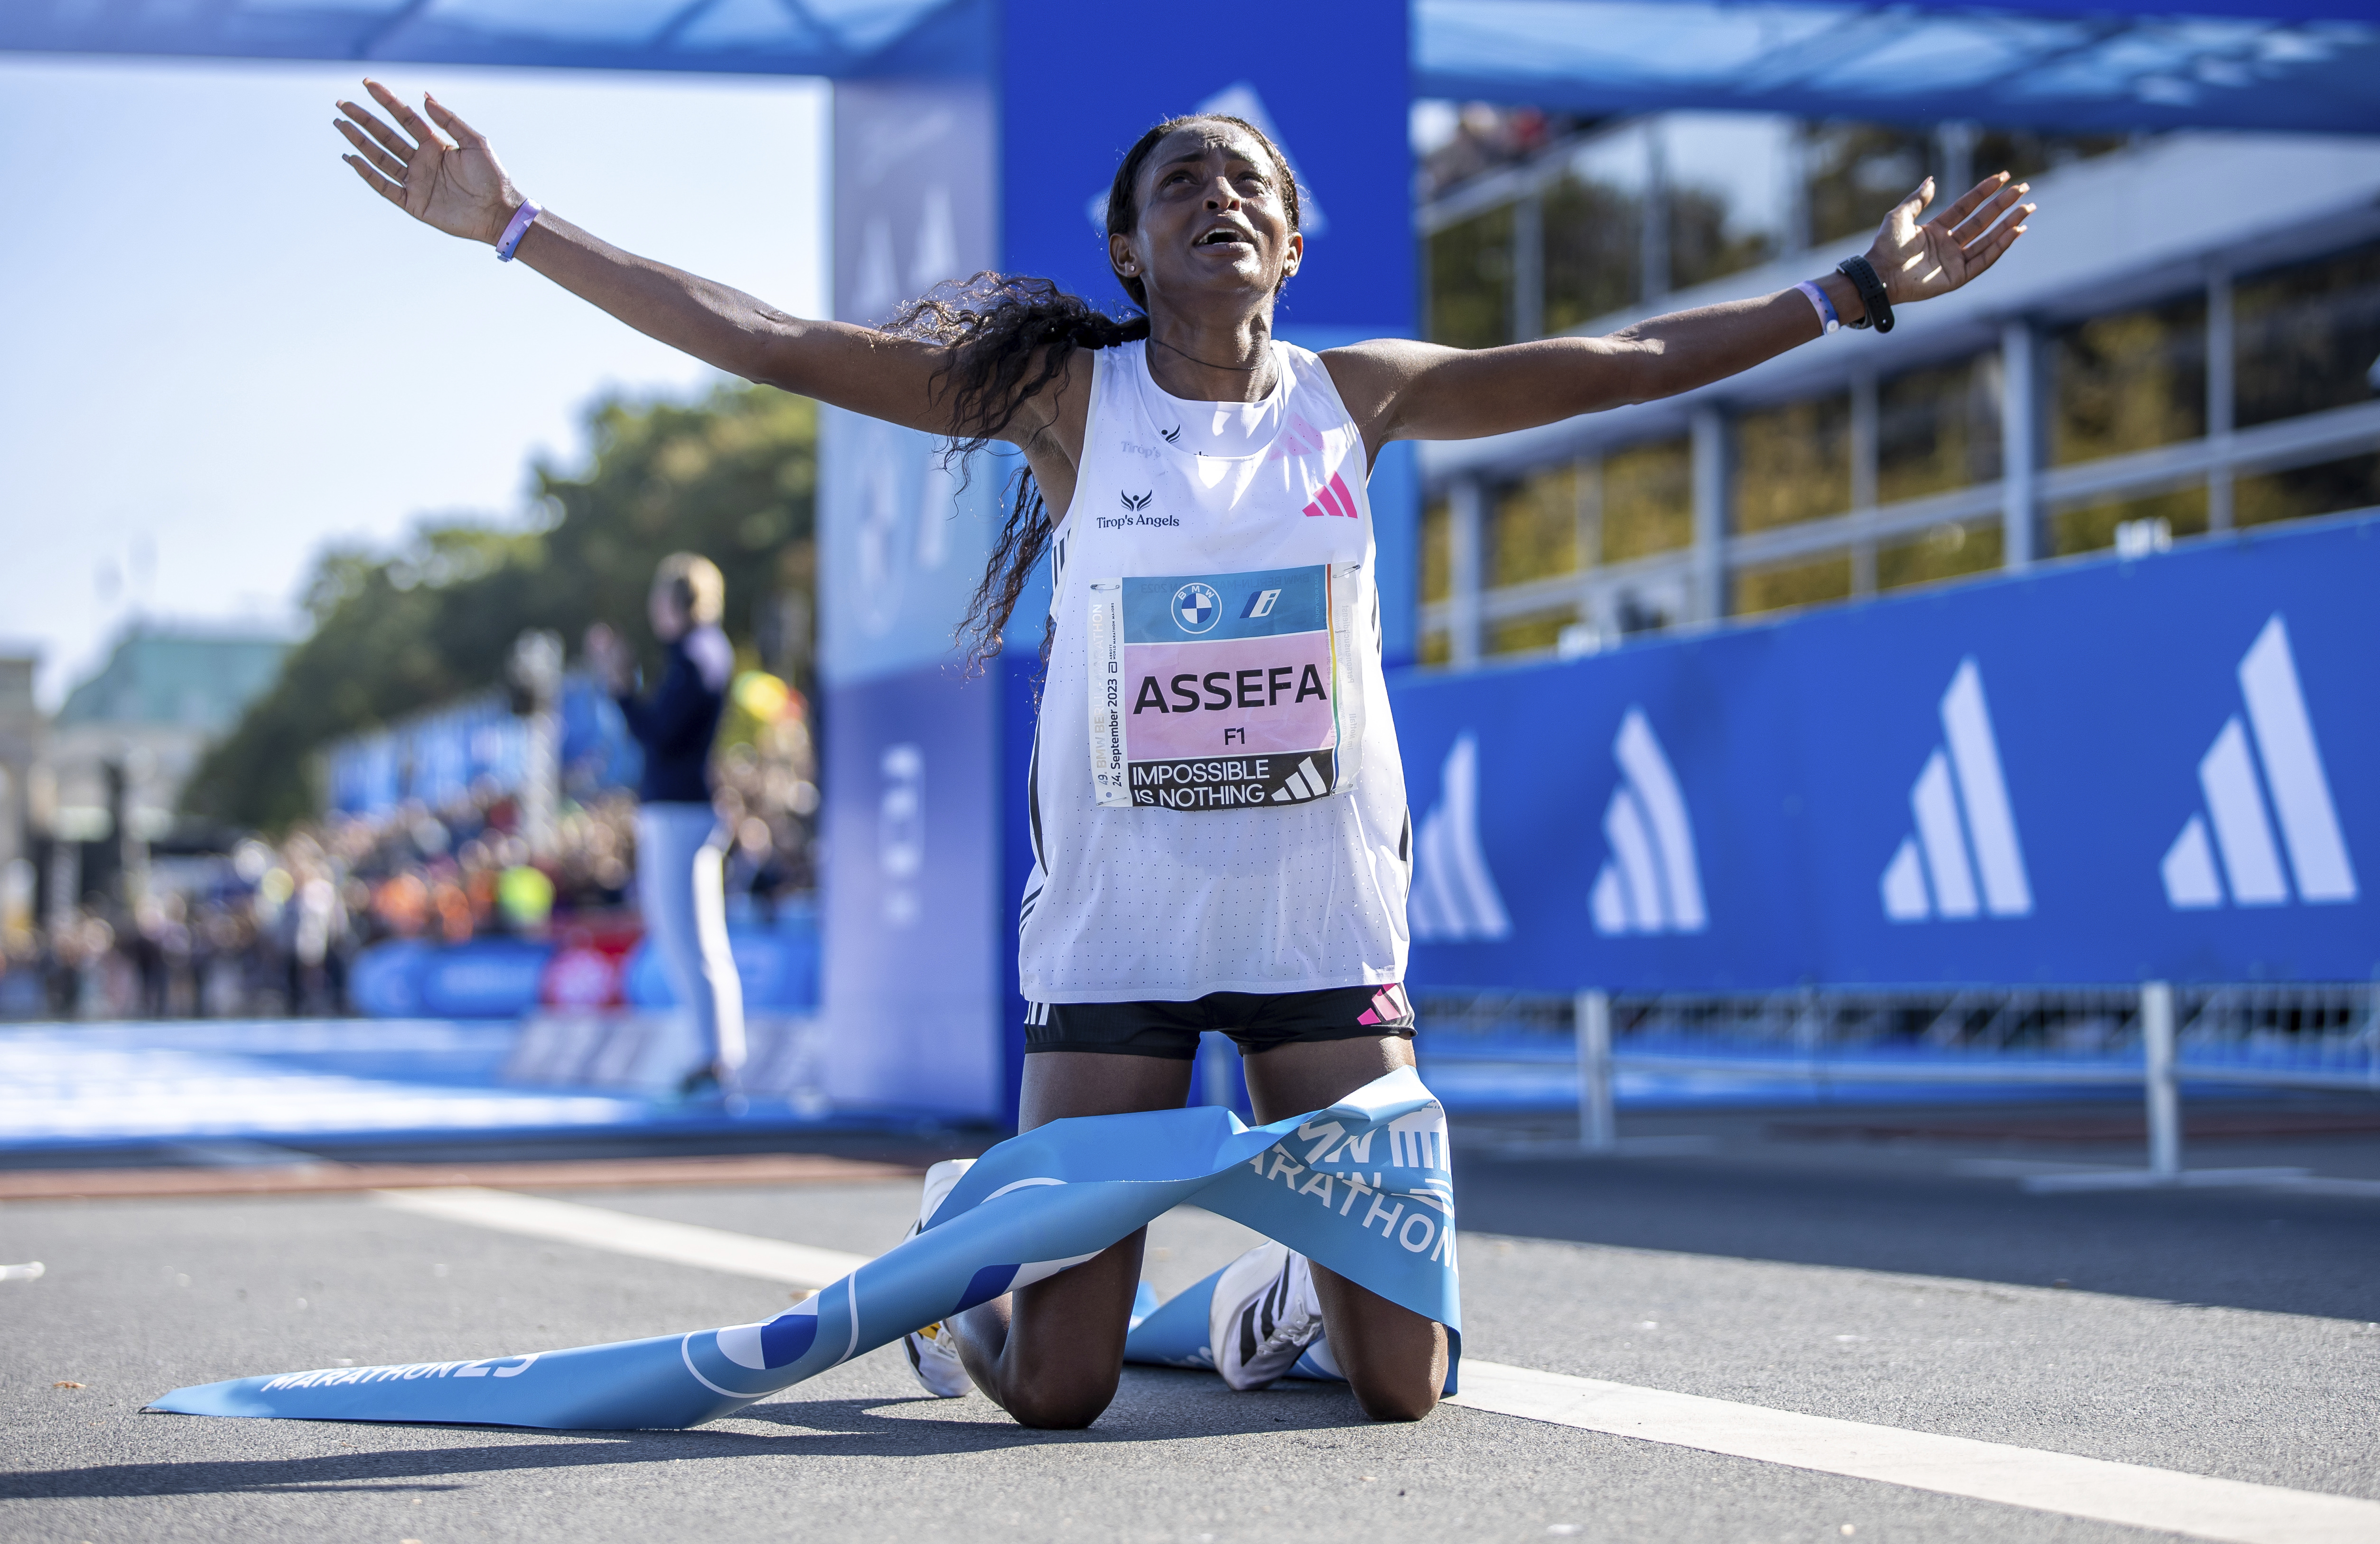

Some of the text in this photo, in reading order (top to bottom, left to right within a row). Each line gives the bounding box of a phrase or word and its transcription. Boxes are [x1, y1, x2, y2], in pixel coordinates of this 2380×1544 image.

[1097, 514, 1180, 530] Tirop's Angels
[1177, 585, 1215, 601] BMW
[1133, 663, 1327, 715] ASSEFA
[1108, 678, 1122, 787] 24. September 2023
[1224, 727, 1245, 746] F1
[1095, 737, 1107, 769] BMW
[1098, 772, 1108, 786] 49.
[1133, 759, 1270, 785] IMPOSSIBLE
[1134, 783, 1265, 807] IS NOTHING
[1249, 1151, 1453, 1268] ARATHON
[260, 1361, 469, 1392] MARATHON
